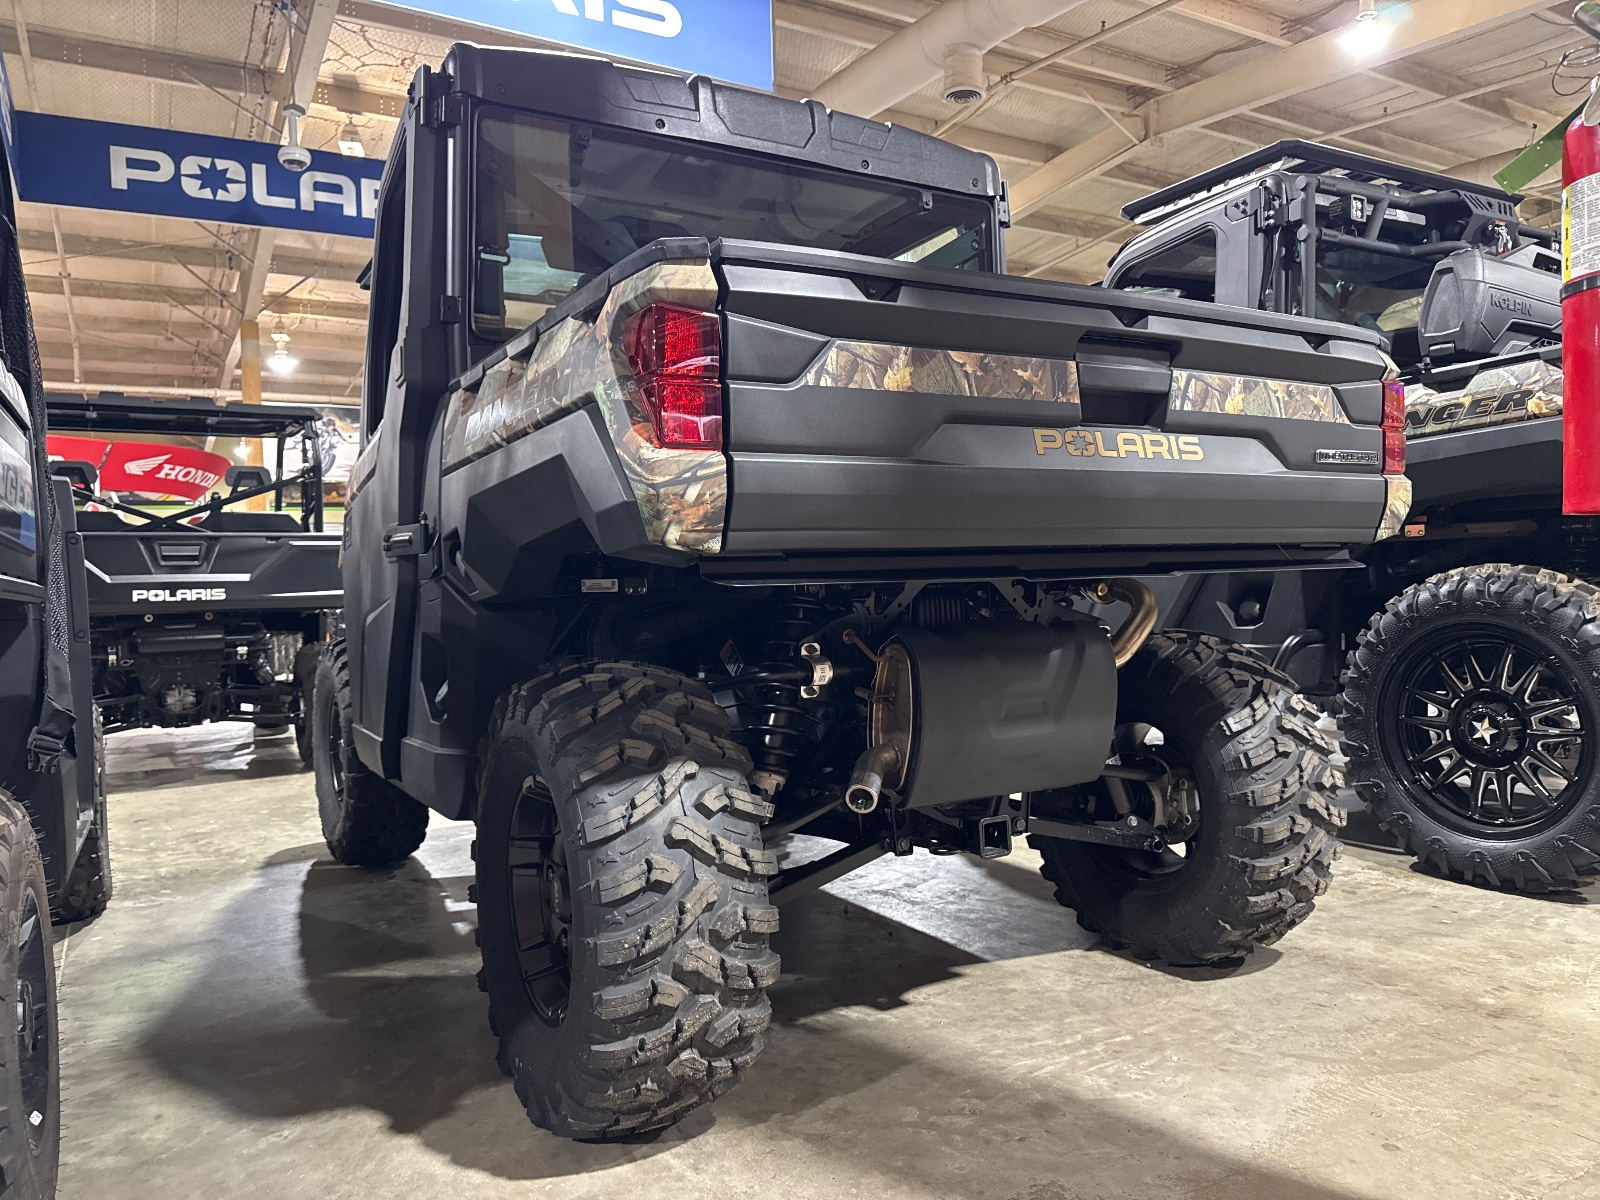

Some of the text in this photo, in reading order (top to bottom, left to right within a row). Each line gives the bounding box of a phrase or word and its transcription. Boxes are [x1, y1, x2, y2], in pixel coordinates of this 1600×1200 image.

[1490, 293, 1532, 316] KOLPIN
[1033, 428, 1204, 461] POLARIS
[1320, 452, 1378, 463] NORTHSTAR
[132, 588, 227, 602] POLARIS
